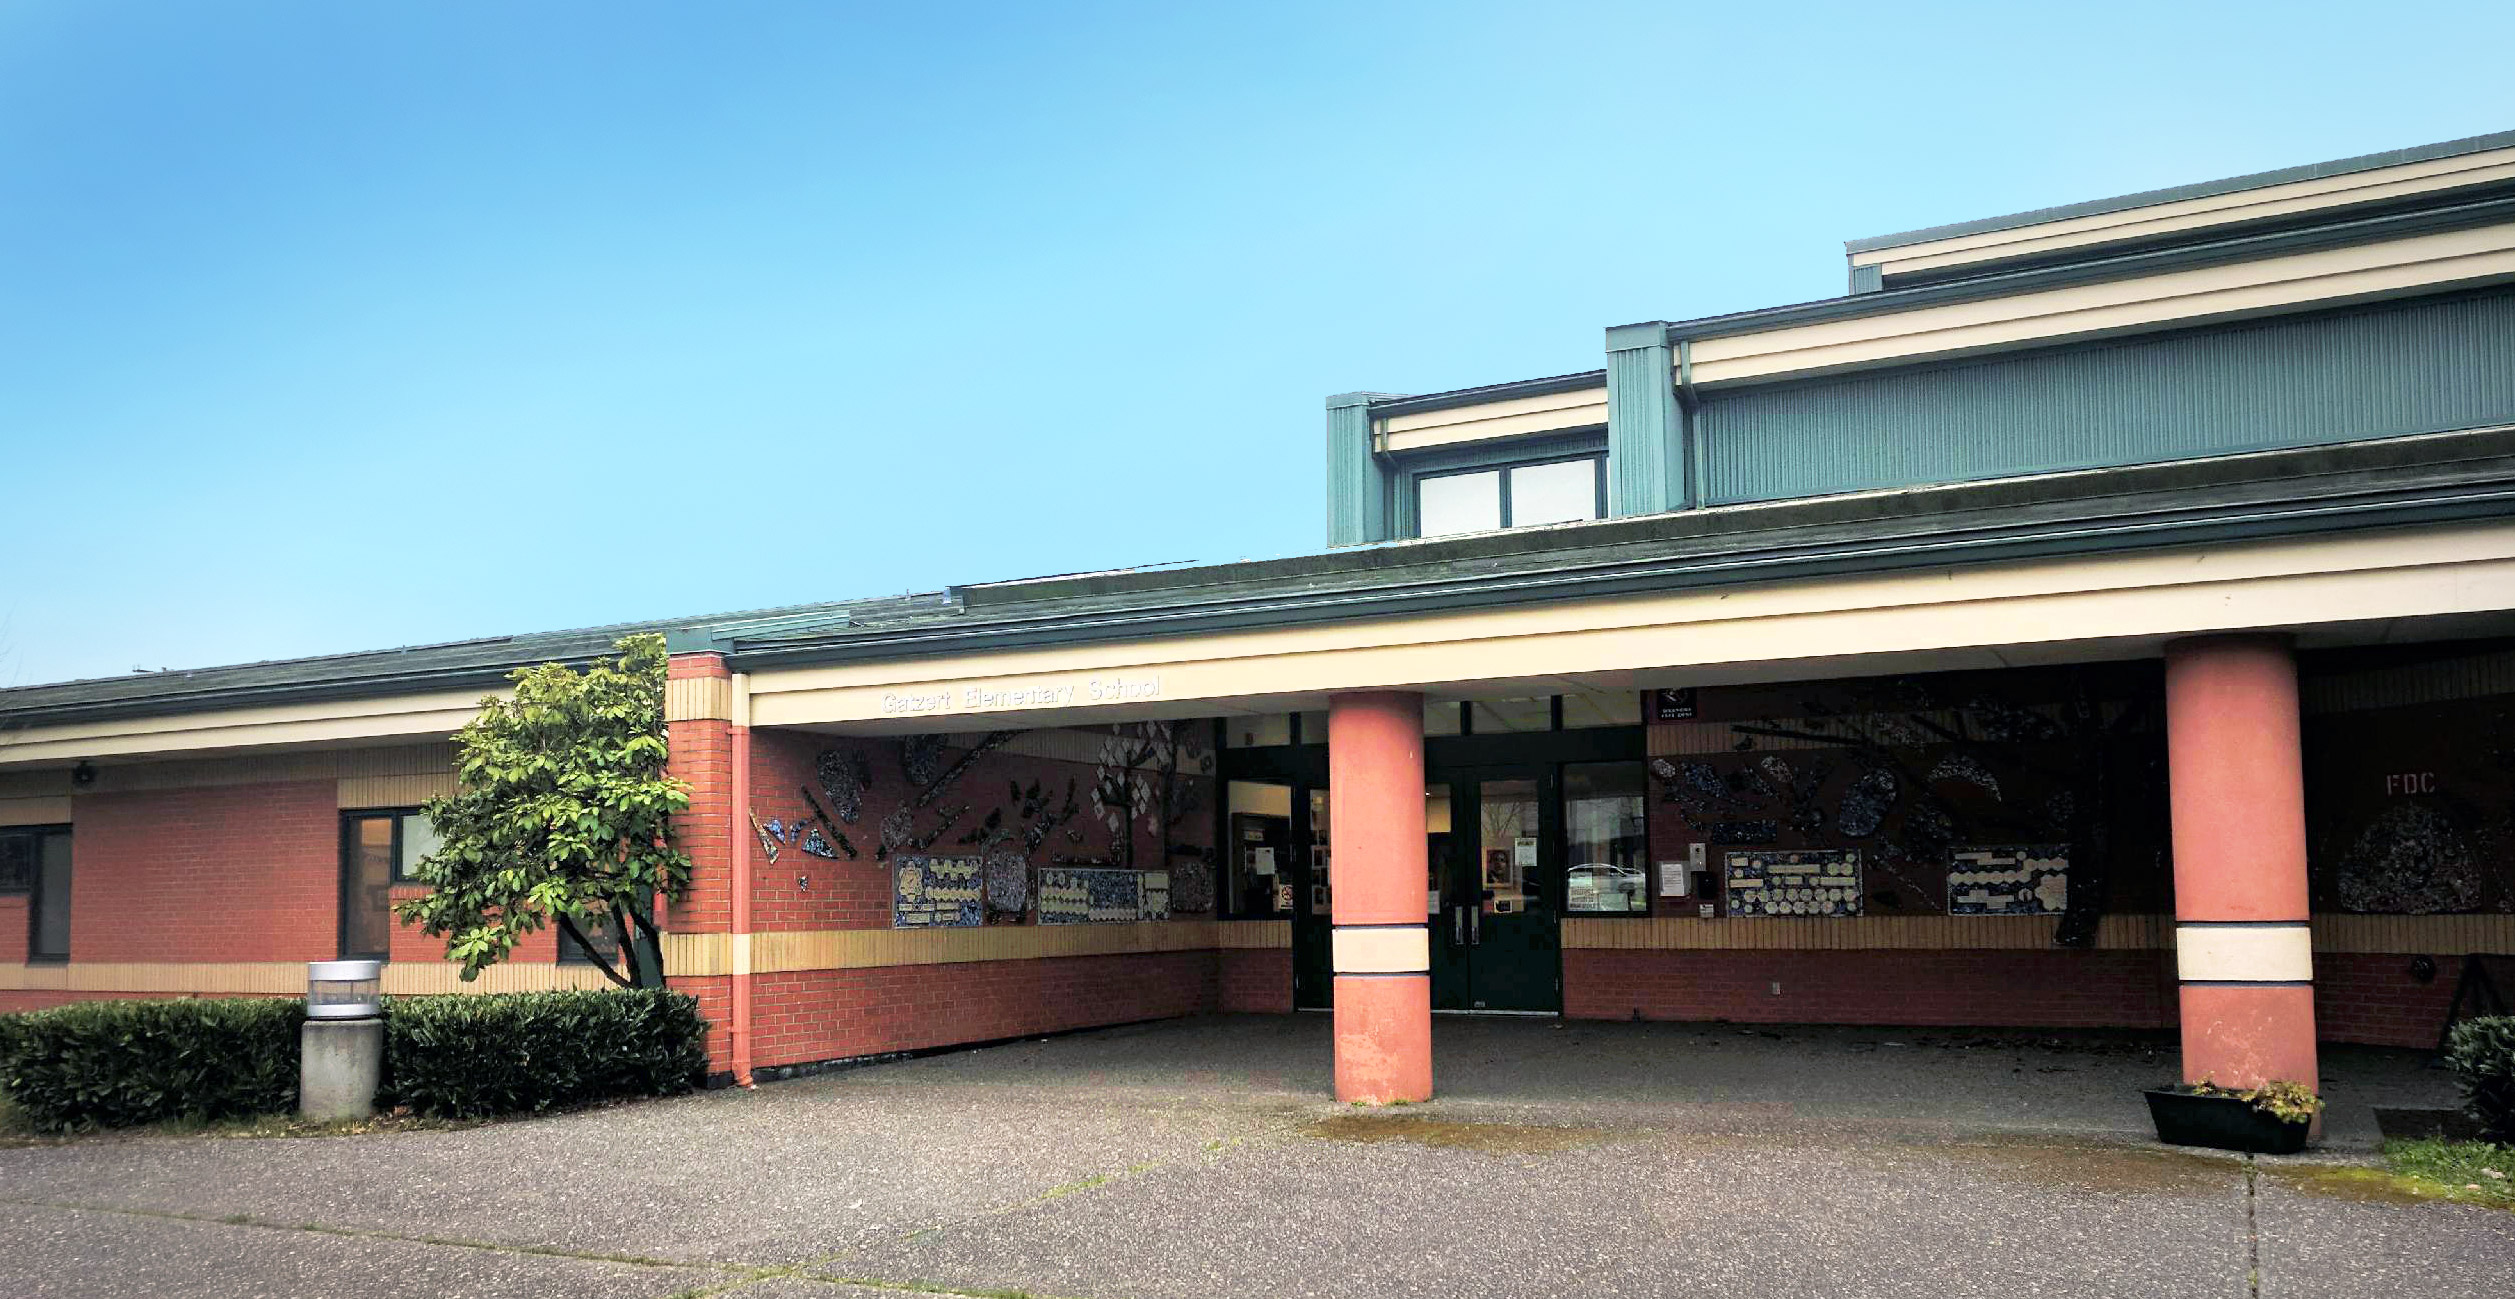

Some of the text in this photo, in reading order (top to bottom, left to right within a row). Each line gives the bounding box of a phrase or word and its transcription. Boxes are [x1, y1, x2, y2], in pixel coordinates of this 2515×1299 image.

[881, 675, 1160, 713] Gatzert Elementary School
[2386, 772, 2435, 795] FDC
